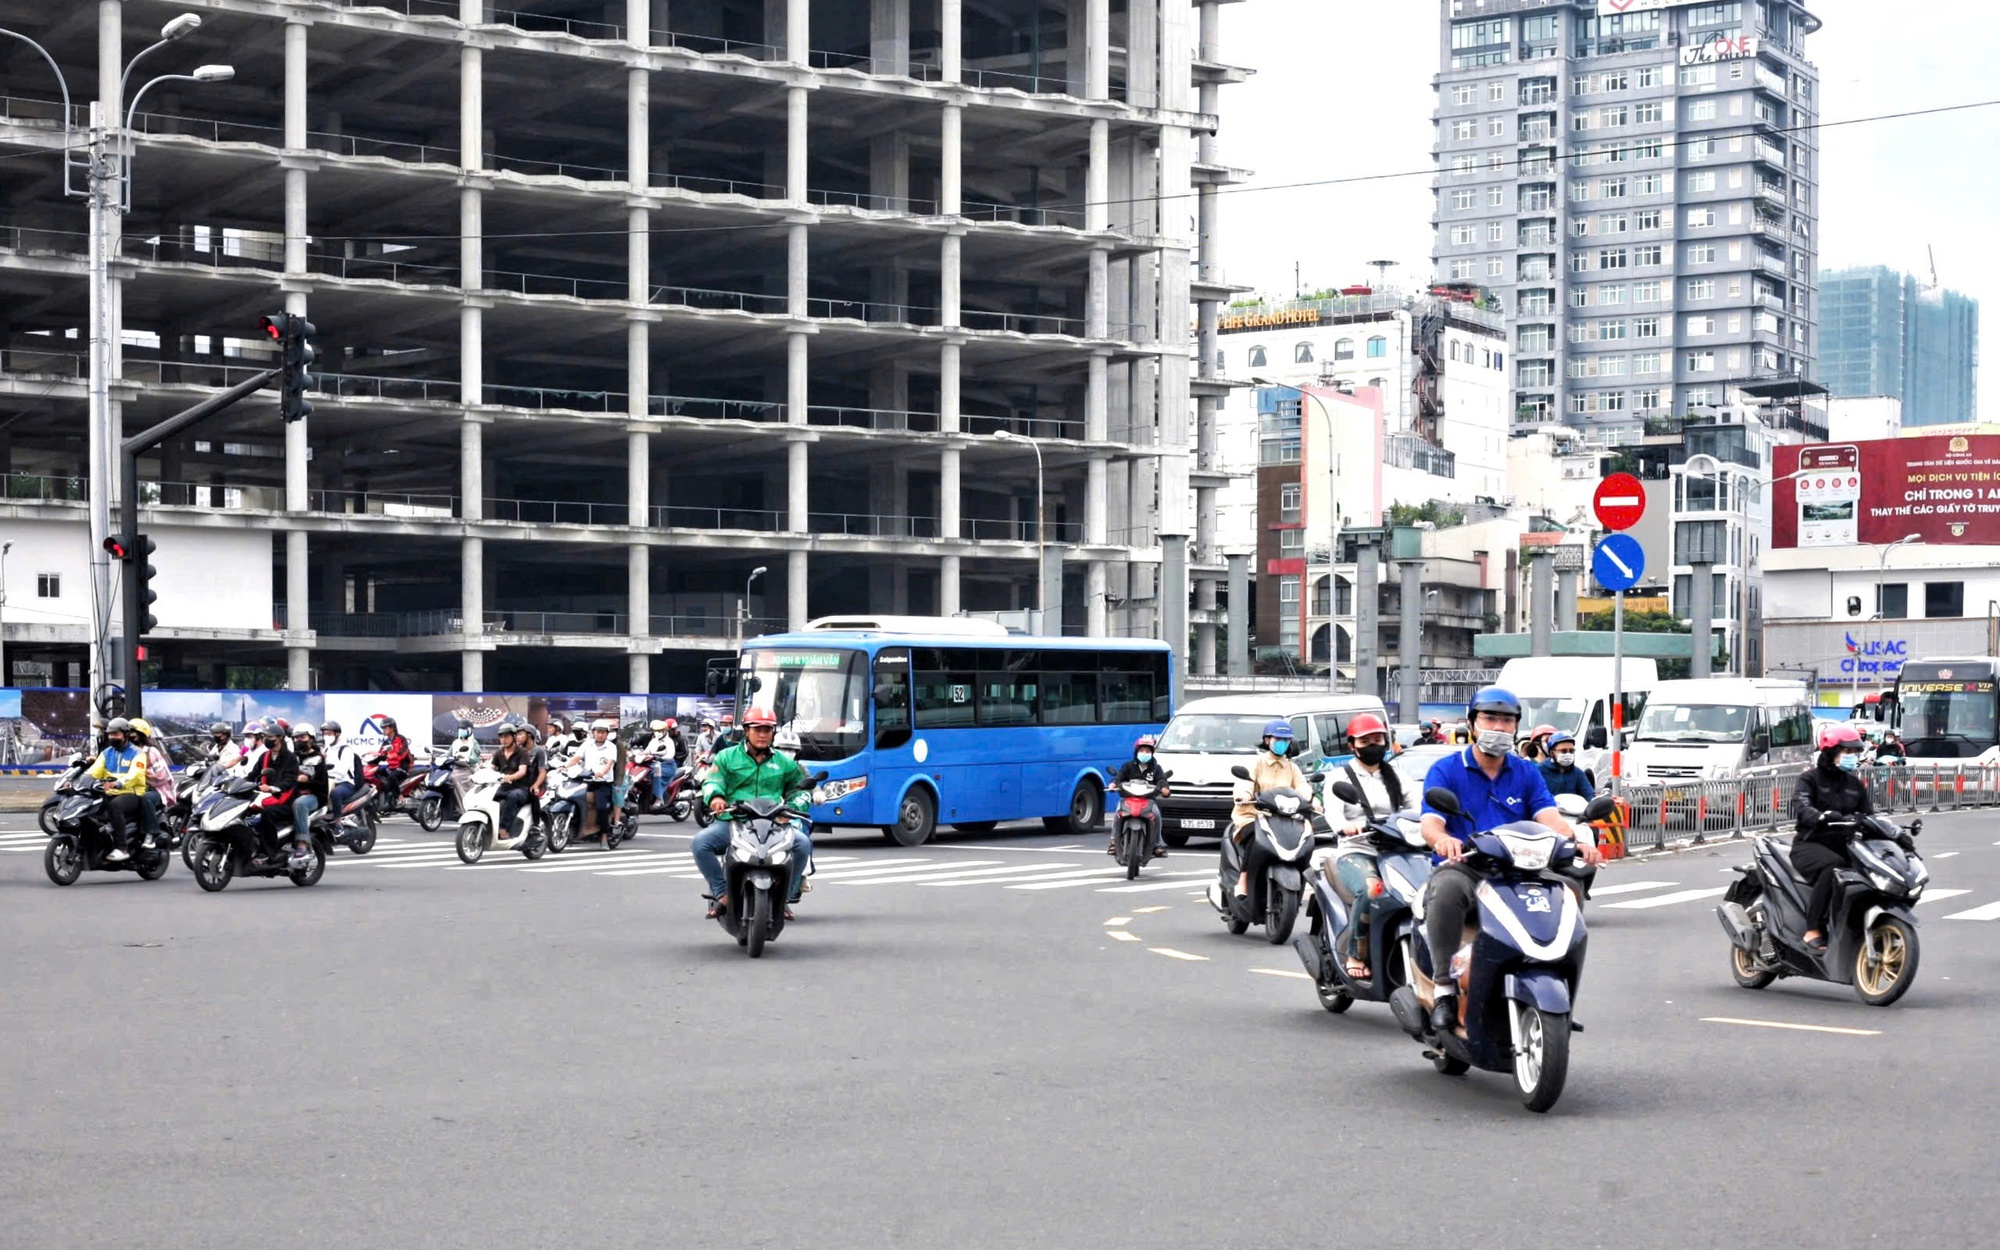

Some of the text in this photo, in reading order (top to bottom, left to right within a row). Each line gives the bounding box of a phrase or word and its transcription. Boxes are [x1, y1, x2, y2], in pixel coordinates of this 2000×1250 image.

[1684, 36, 1750, 64] The ONE
[1244, 311, 1283, 327] GRAND
[1285, 307, 1319, 324] HOTEL
[1907, 474, 1926, 483] MỌI
[1929, 473, 1953, 482] DỊCH
[1955, 473, 1967, 482] VỤ
[1904, 487, 1926, 501] CHỈ
[1929, 488, 1974, 500] TRONG
[1977, 488, 1983, 499] 1
[1870, 507, 1893, 517] THAY
[1894, 504, 1912, 516] THẾ
[1913, 504, 1934, 514] CÁC
[1936, 502, 1961, 514] GIẤY
[1962, 502, 1976, 513] TỜ
[1863, 640, 1907, 656] USAC
[955, 686, 964, 701] 52
[1899, 683, 1964, 692] UNIVERSE
[346, 737, 375, 746] HCMC
